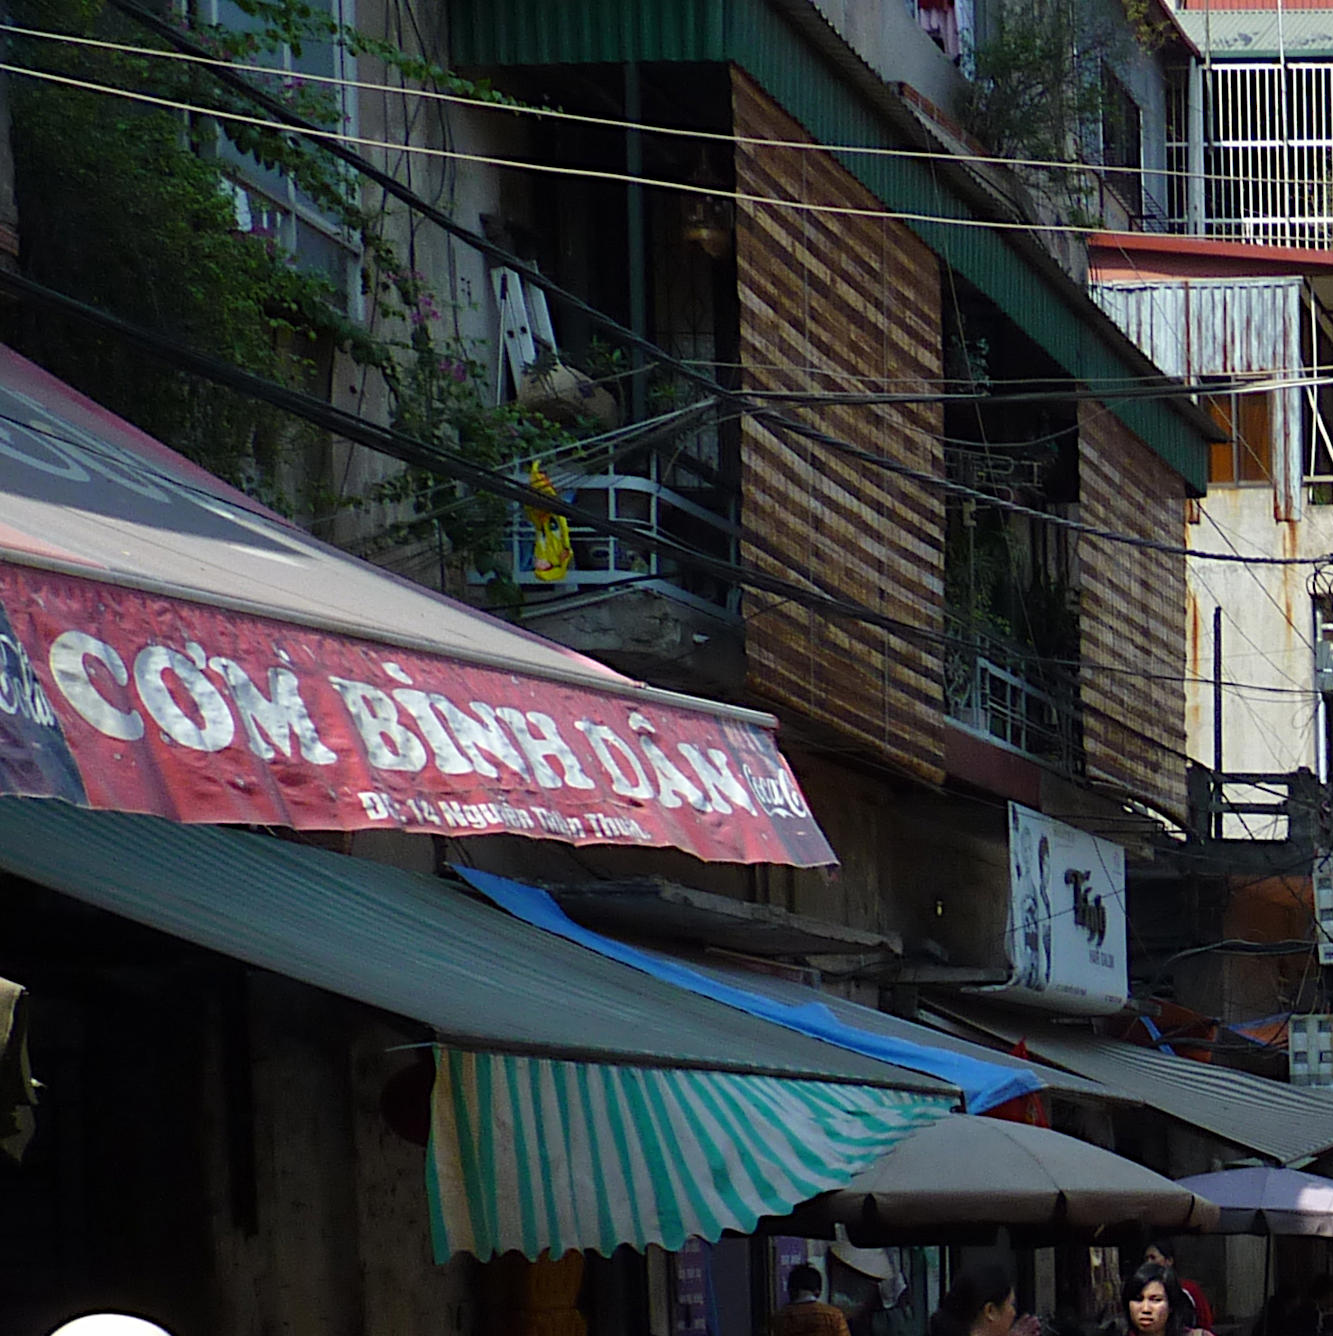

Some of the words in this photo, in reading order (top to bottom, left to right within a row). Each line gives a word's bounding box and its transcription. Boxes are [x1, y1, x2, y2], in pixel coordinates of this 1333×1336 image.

[50, 631, 337, 765] CƠM
[329, 662, 594, 789] BÌNH
[574, 711, 758, 817] DÂN
